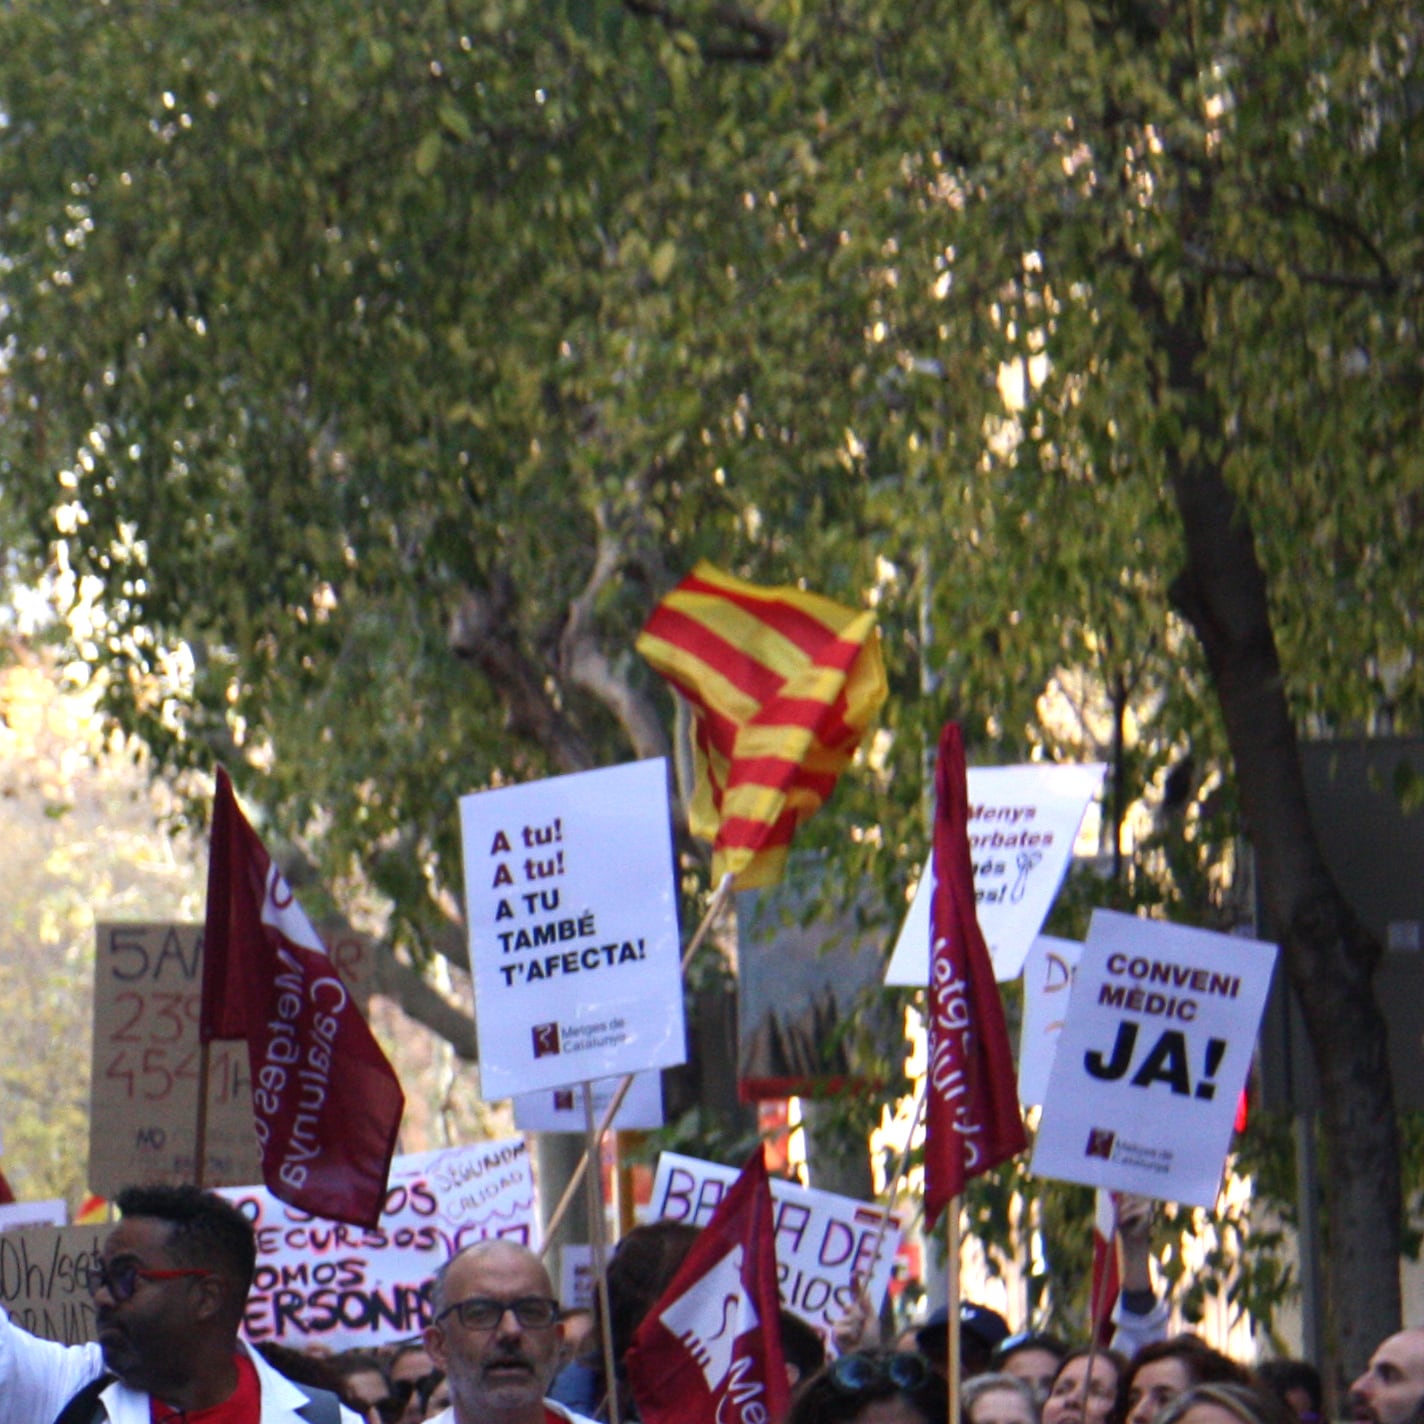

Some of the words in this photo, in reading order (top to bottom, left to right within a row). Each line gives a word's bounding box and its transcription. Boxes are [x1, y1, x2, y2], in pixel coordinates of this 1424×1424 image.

[490, 830, 512, 856] A
[522, 818, 563, 848] tu!
[492, 863, 514, 889] A
[524, 851, 565, 881] tu!
[495, 899, 514, 922] A
[521, 888, 561, 915] TU
[497, 909, 596, 954] TAMBÉ
[500, 938, 647, 987] T'AFECTA!
[1106, 952, 1242, 998] CONVENI
[1098, 982, 1199, 1022] MÈDIC
[1083, 1019, 1228, 1101] JA!
